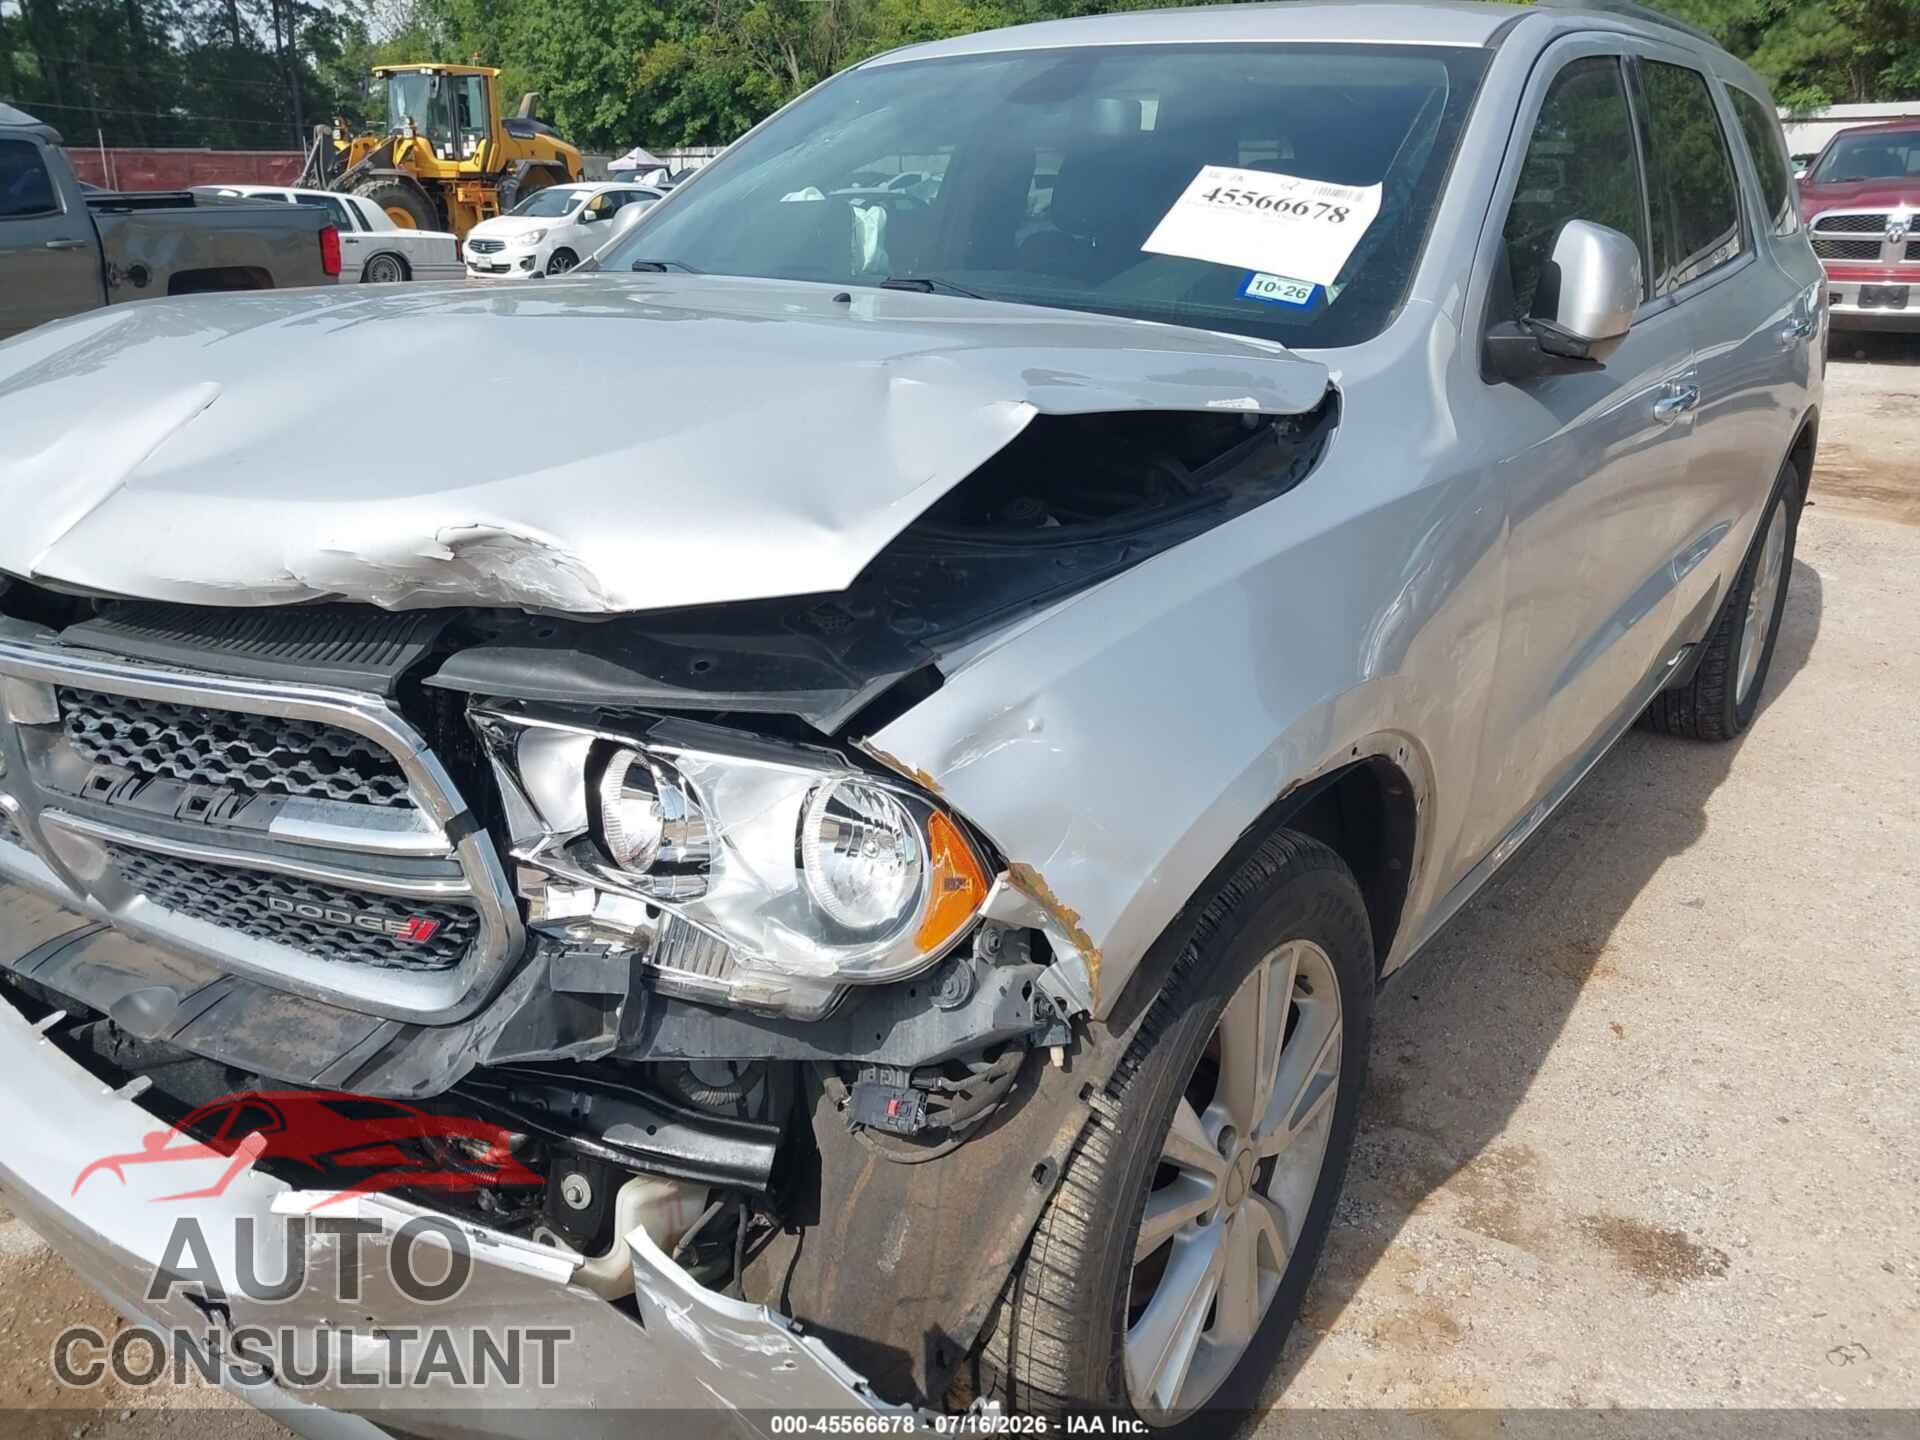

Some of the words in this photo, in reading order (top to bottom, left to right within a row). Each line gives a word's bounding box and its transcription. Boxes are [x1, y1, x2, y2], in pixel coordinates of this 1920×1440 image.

[1202, 186, 1351, 224] 45566678
[1255, 280, 1277, 293] 10
[1283, 286, 1309, 299] 26
[268, 896, 413, 936] DODGE
